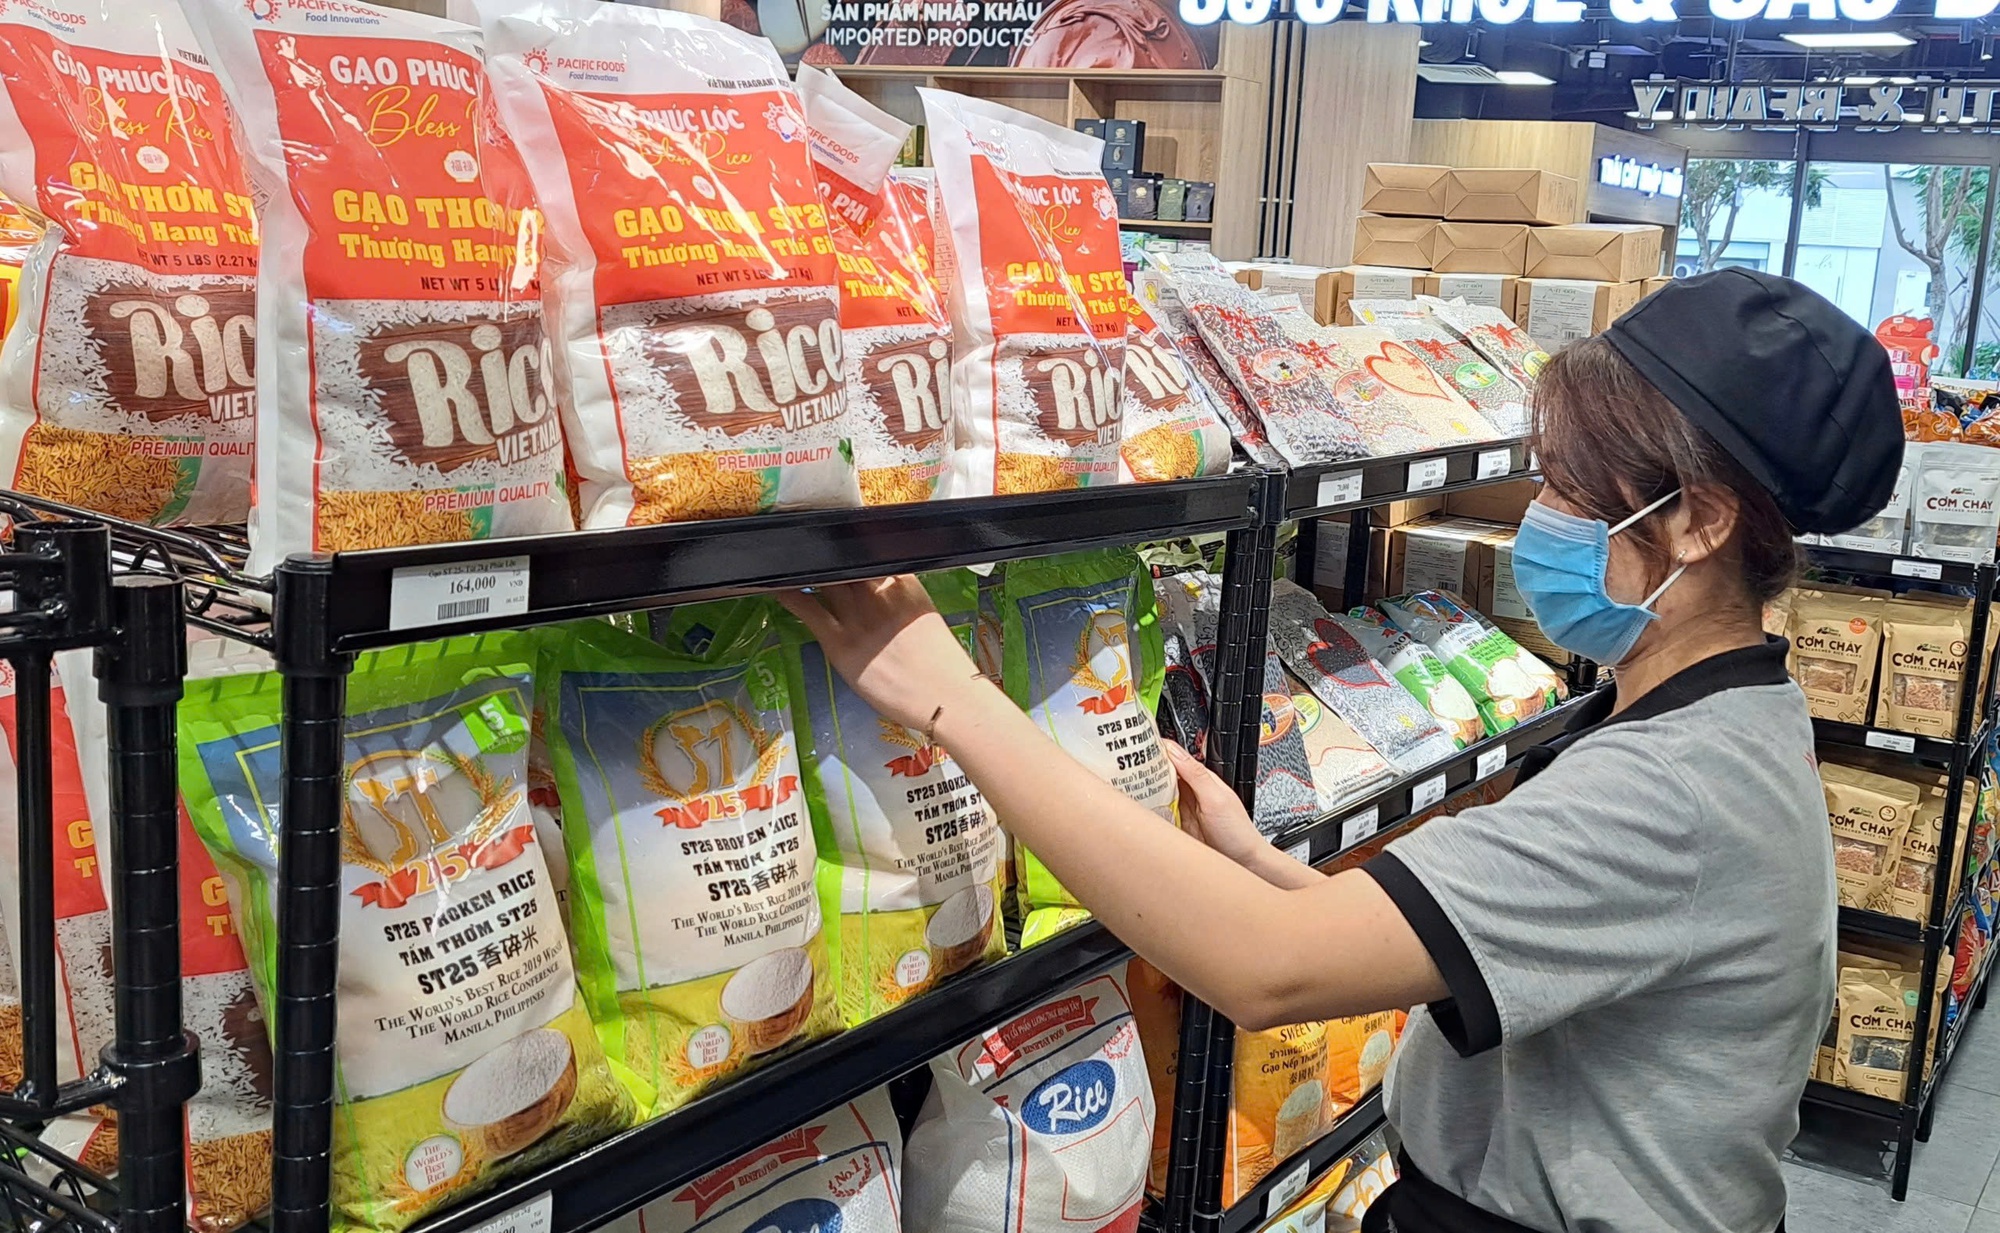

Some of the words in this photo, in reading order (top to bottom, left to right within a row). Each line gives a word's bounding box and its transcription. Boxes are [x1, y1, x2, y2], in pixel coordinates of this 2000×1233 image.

[305, 12, 327, 24] Food
[330, 13, 380, 26] Innovations
[825, 28, 921, 48] IMPORTED
[926, 26, 1035, 47] PRODUCTS
[330, 55, 398, 92] GẠO
[557, 57, 594, 71] PACIFIC
[596, 58, 626, 73] FOODS
[365, 85, 461, 148] Bless
[700, 104, 745, 135] LỘC
[827, 140, 860, 164] FOODS
[120, 181, 218, 215] THƠM
[1052, 183, 1082, 209] LỘC
[332, 189, 410, 232] GẠO
[150, 221, 219, 247] Hạng
[613, 205, 684, 242] GẠO
[150, 255, 169, 267] WT
[173, 255, 182, 267] 5
[186, 254, 212, 267] LBS
[215, 254, 246, 269] (2.27
[338, 232, 445, 268] Thượng
[622, 241, 719, 270] Thượng
[769, 236, 809, 258] Thế
[421, 276, 444, 292] NET
[450, 276, 471, 292] WT
[476, 277, 485, 291] 5
[697, 268, 719, 286] NET
[723, 268, 742, 284] WT
[743, 268, 751, 281] 5
[1012, 290, 1073, 312] Thượng
[1089, 297, 1116, 316] Thế
[662, 308, 845, 415] Rice
[130, 441, 204, 457] PREMIUM
[717, 453, 782, 471] PREMIUM
[785, 447, 833, 466] QUALITY
[909, 464, 940, 482] PREMIUM
[1058, 461, 1091, 474] PREMIUM
[1092, 461, 1118, 473] QUALITY
[424, 489, 495, 512] PREMIUM
[499, 482, 550, 503] QUALITY
[1927, 495, 1959, 510] CƠM
[450, 575, 496, 594] 164,000
[1796, 635, 1824, 649] CƠM
[1892, 652, 1924, 666] CƠM
[756, 663, 775, 687] 5
[480, 703, 505, 729] 5
[1097, 721, 1122, 736] ST25
[1106, 735, 1127, 751] TẤM
[1117, 749, 1146, 770] ST25
[907, 783, 936, 803] ST25
[701, 790, 747, 822] 25
[915, 803, 940, 822] TẤM
[926, 819, 957, 845] ST25
[681, 835, 714, 855] ST25
[894, 857, 915, 869] THE
[917, 847, 947, 864] WORLD'S
[948, 841, 963, 853] BEST
[693, 857, 723, 877] TẤM
[915, 866, 930, 878] THE
[932, 859, 956, 872] WORLD
[708, 879, 750, 901] ST25
[384, 918, 420, 942] ST25
[498, 870, 536, 898] RICE
[671, 916, 695, 931] THE
[697, 904, 743, 924] WORLD'S
[743, 901, 764, 913] BEST
[767, 893, 787, 909] RICE
[399, 943, 434, 967] TẤM
[437, 924, 494, 953] THƠM
[500, 897, 537, 928] ST25
[694, 925, 717, 940] THE
[719, 915, 757, 932] WORLD
[759, 908, 780, 924] RICE
[723, 927, 764, 948] MANILA,
[417, 954, 479, 995] ST25
[478, 925, 540, 970] 香碎米
[375, 1014, 406, 1032] THE
[408, 995, 463, 1023] WORLD'S
[464, 982, 495, 1002] BEST
[497, 969, 521, 988] RICE
[523, 955, 542, 974] 2019
[406, 1021, 436, 1040] THE
[439, 1005, 483, 1029] WORLD
[485, 991, 511, 1010] RICE
[511, 963, 559, 996] CONFERENCE
[444, 1018, 494, 1046] MANILA,
[494, 988, 546, 1024] PHILIPPINES
[1850, 1014, 1880, 1028] CƠM
[1039, 1079, 1108, 1132] Rice
[413, 1147, 453, 1170] WORLD'S
[424, 1143, 441, 1156] THE
[424, 1161, 446, 1177] BEST
[426, 1171, 447, 1186] RICE
[834, 1157, 862, 1188] No.1
